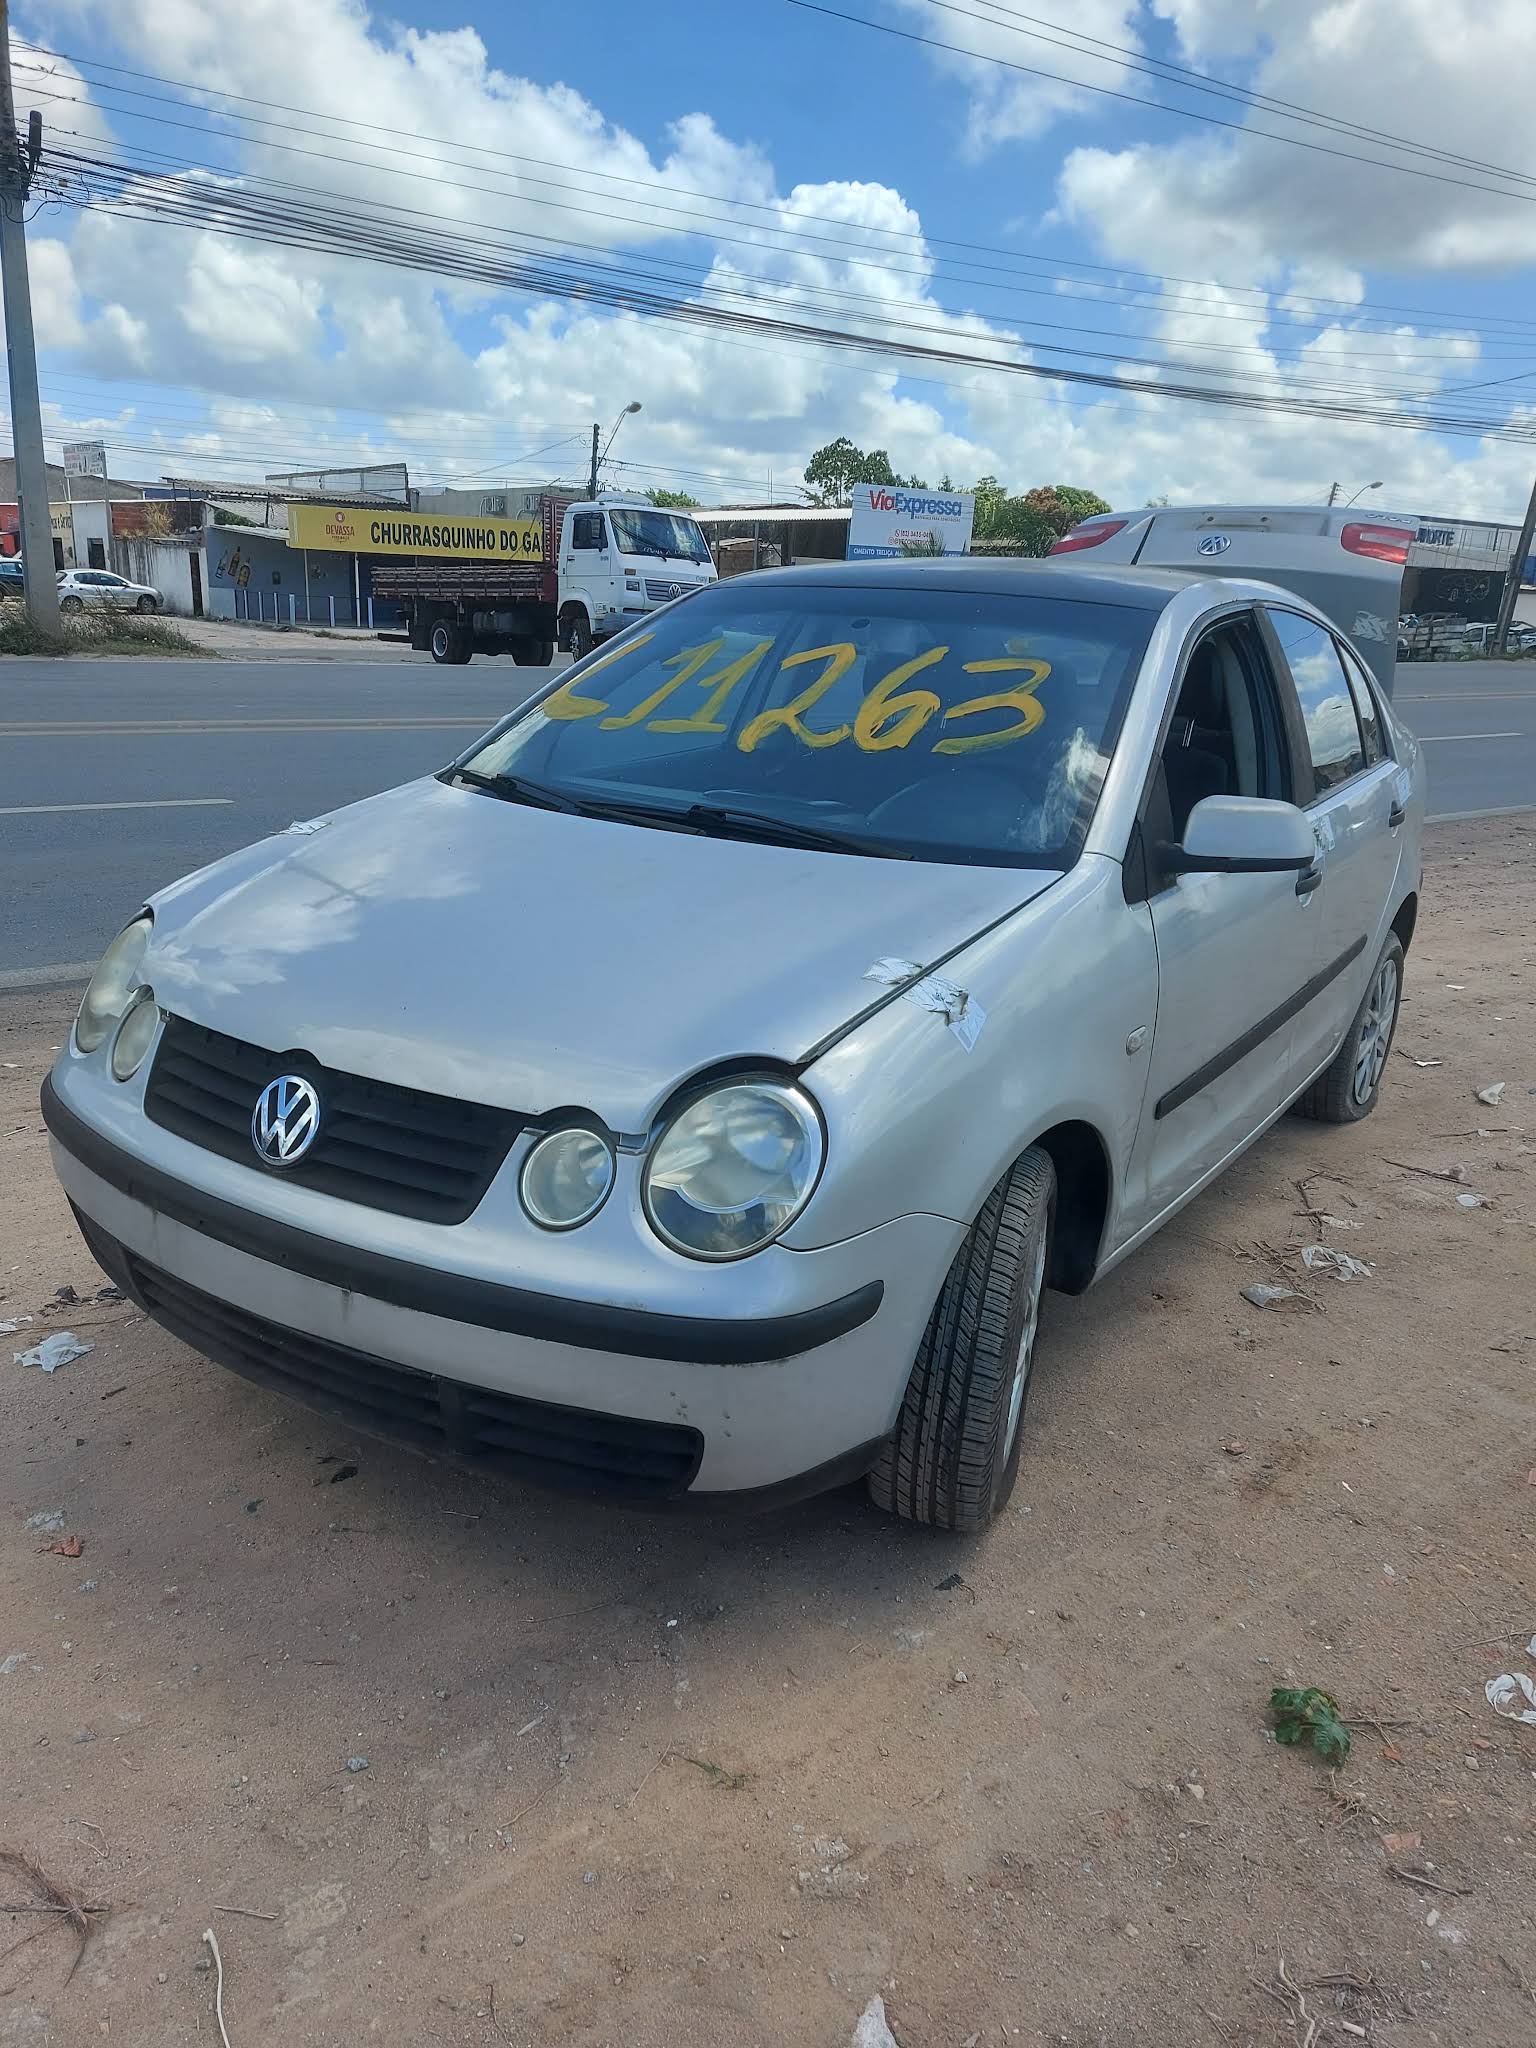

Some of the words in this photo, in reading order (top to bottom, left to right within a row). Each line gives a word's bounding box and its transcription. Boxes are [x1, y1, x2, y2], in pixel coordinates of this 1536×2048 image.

[325, 524, 355, 537] DEVASSA
[370, 521, 496, 550] CHURRASQUINHO
[500, 530, 518, 552] DO
[522, 531, 544, 553] GA
